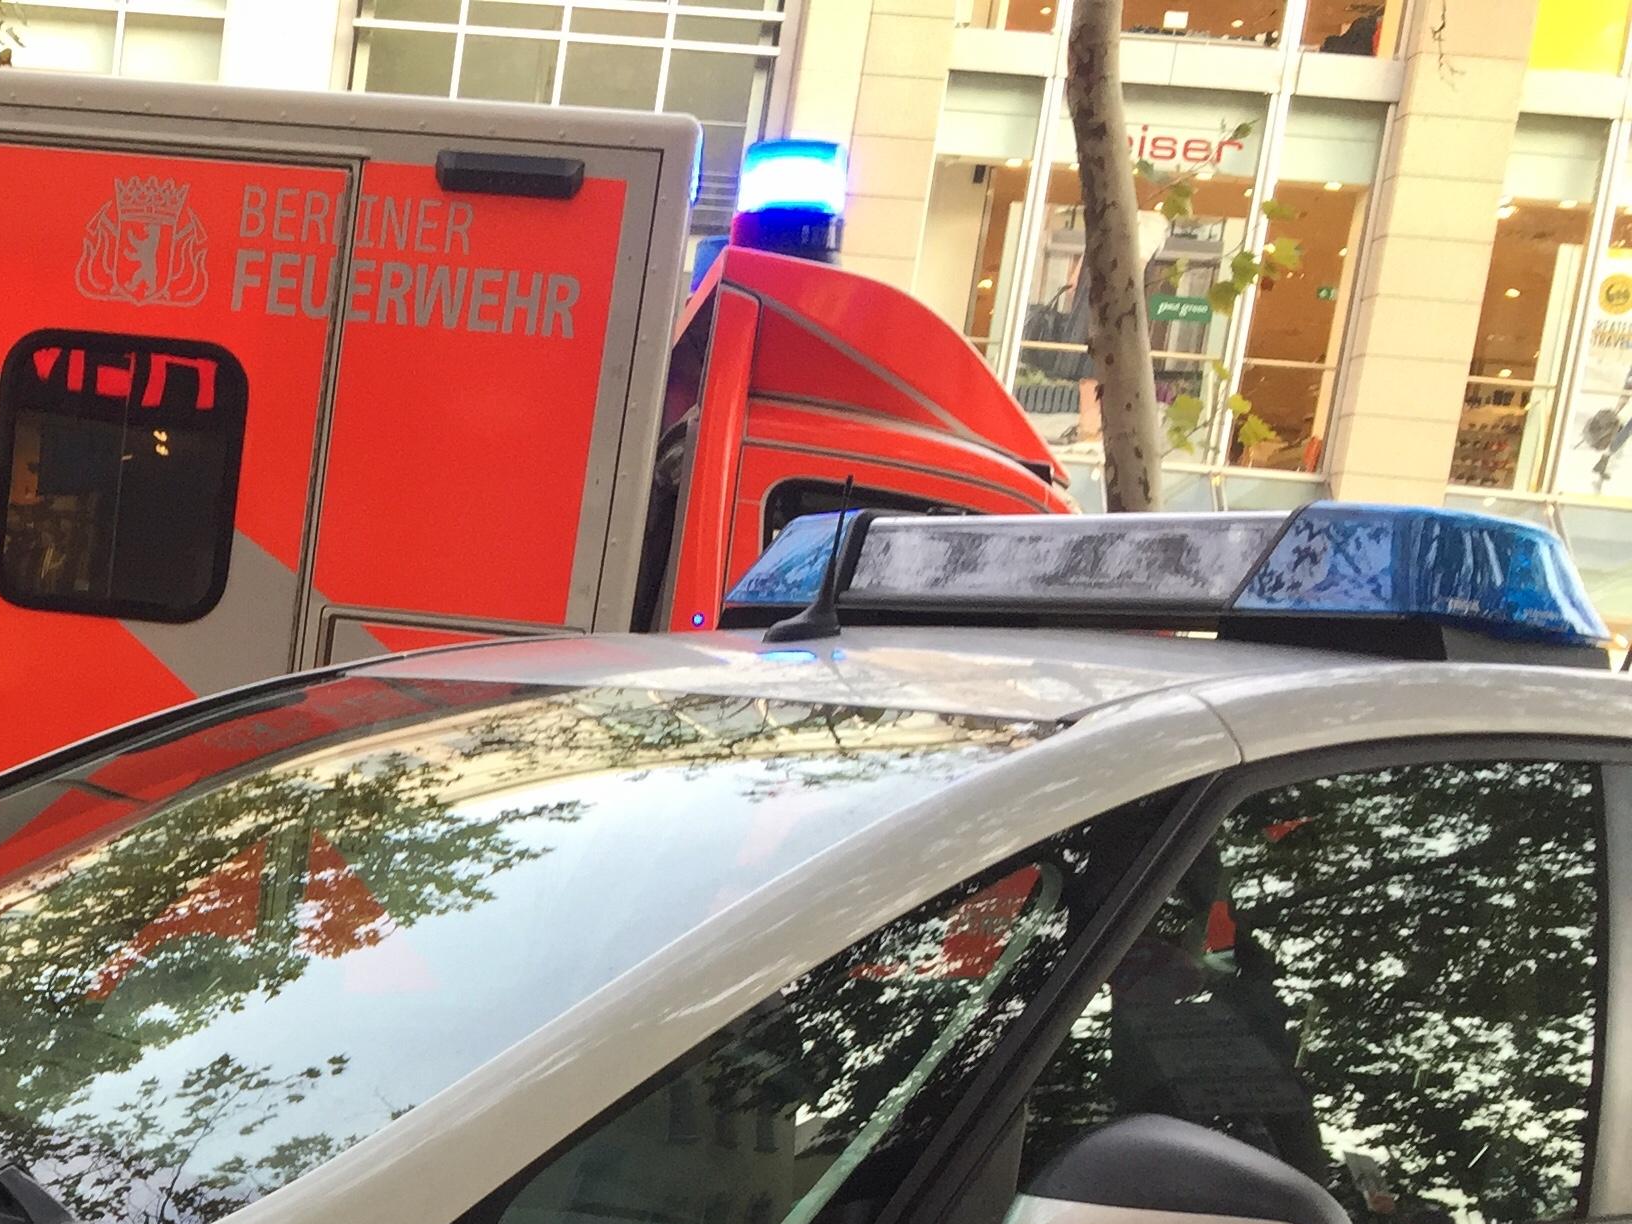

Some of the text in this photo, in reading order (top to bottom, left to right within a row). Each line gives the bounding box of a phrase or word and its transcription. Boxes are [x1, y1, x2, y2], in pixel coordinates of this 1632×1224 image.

[1128, 125, 1244, 164] iser
[240, 186, 474, 254] BERLINER
[231, 251, 581, 338] FEUERWEHR
